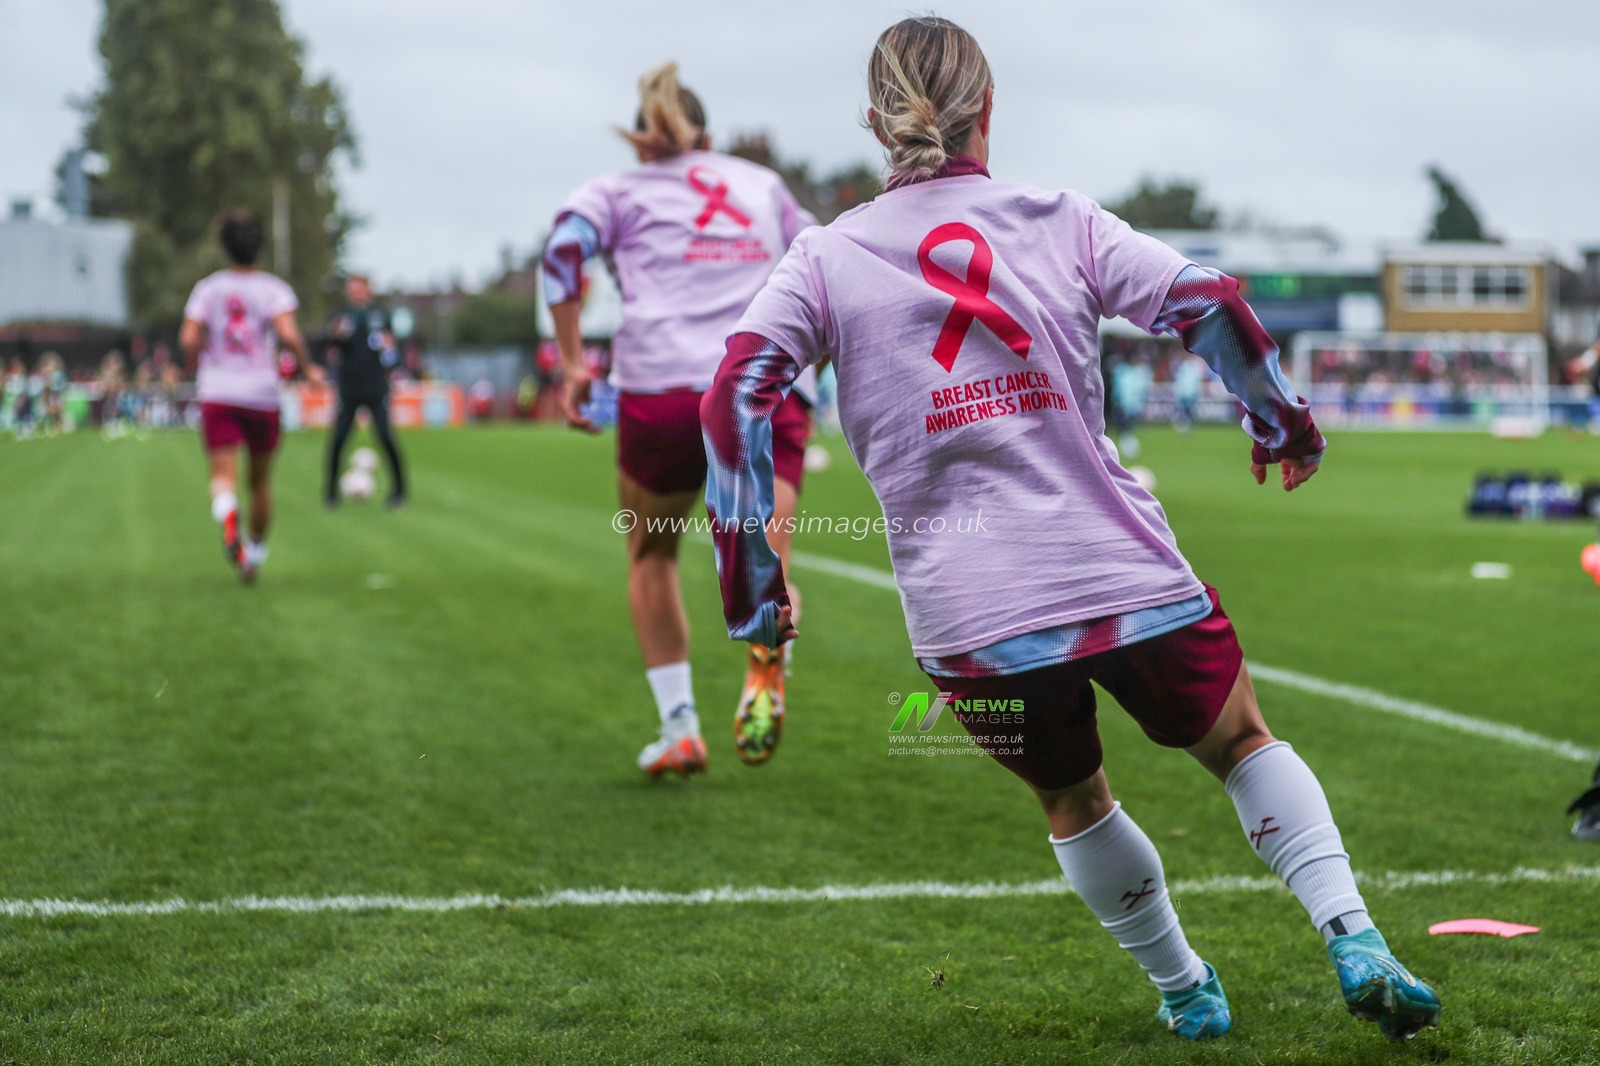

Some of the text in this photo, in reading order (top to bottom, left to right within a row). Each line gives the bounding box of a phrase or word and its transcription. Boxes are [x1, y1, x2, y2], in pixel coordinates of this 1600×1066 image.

[931, 371, 1052, 410] BREAST CANCER
[925, 392, 1067, 434] AWARENESS MONTH
